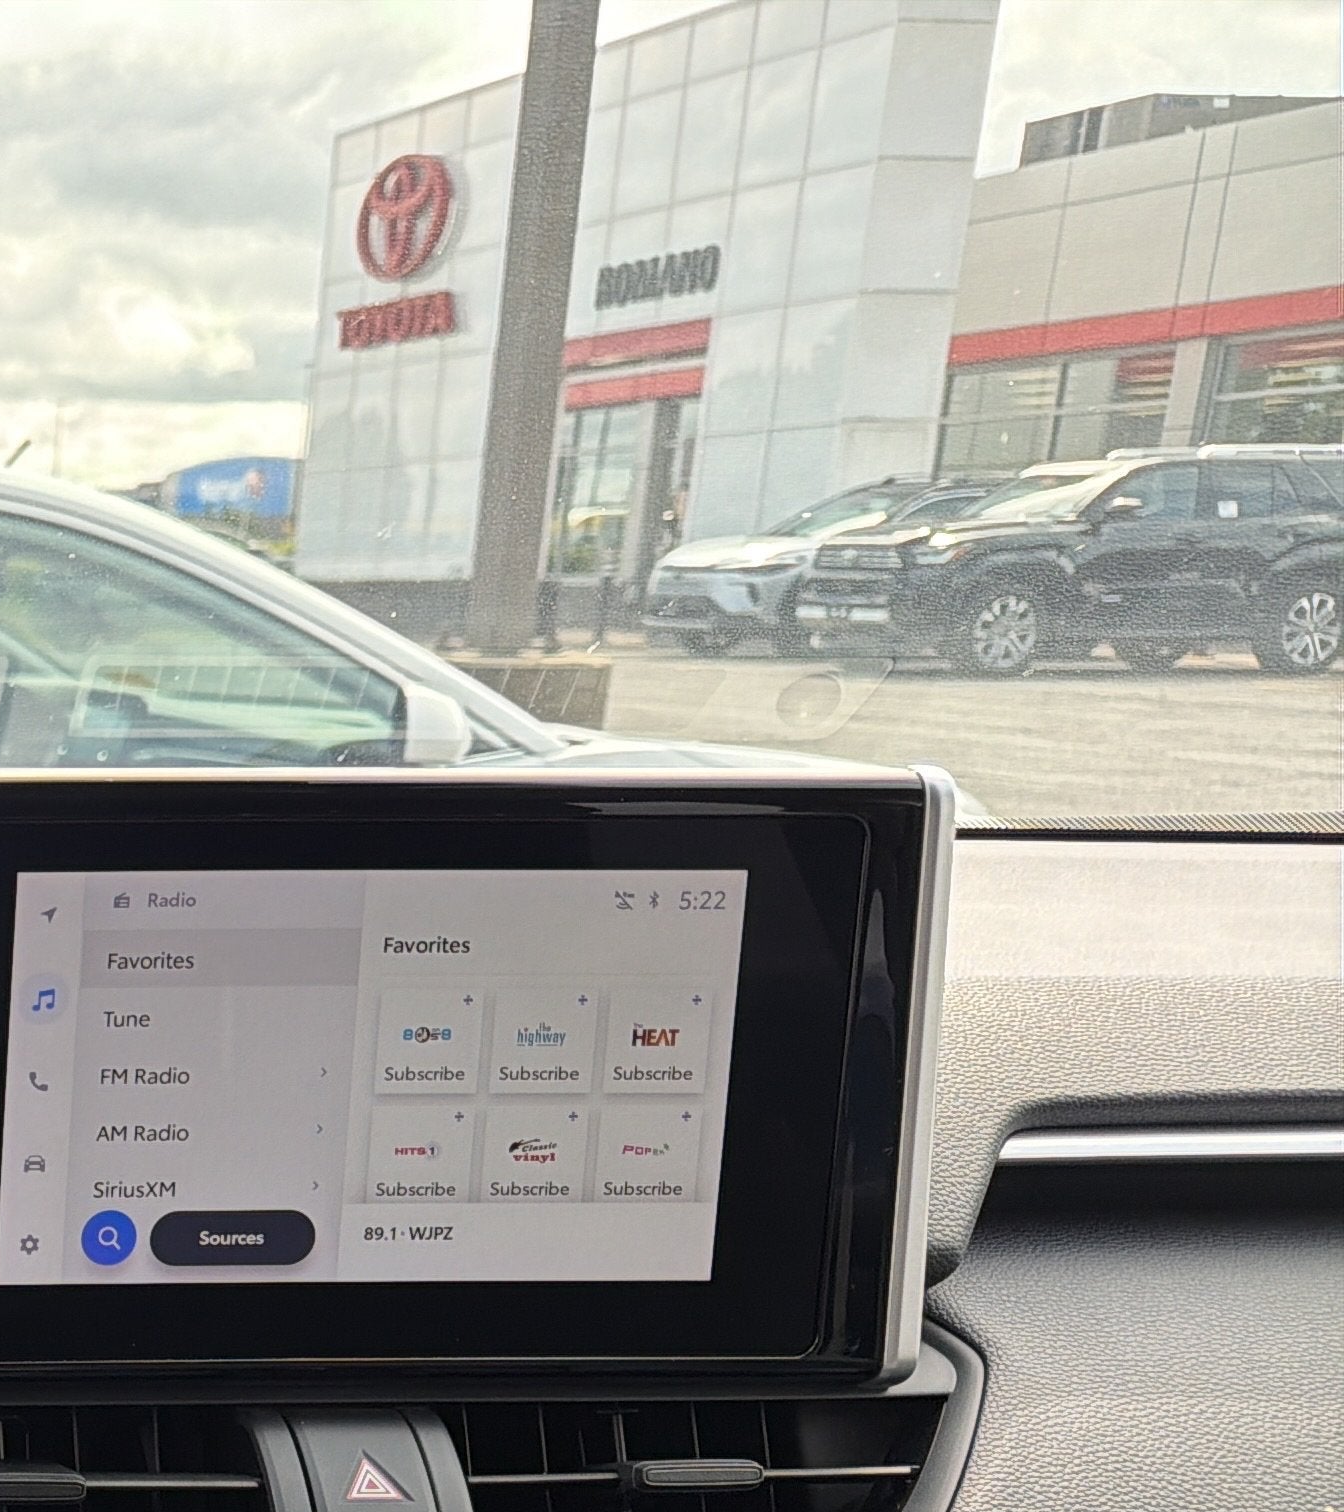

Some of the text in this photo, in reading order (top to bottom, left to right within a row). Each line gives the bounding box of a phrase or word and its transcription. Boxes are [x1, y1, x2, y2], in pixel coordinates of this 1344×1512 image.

[147, 892, 197, 908] Radio
[678, 890, 727, 910] 5:22
[383, 936, 471, 954] Favorites
[106, 951, 195, 970] Favorites
[103, 1010, 151, 1028] Tune
[516, 1027, 567, 1047] highway
[631, 1028, 680, 1047] HEAT
[100, 1066, 190, 1085] FM Radio
[384, 1066, 465, 1082] Subscribe
[499, 1066, 580, 1082] Subscribe
[612, 1066, 693, 1082] Subscribe
[96, 1123, 190, 1142] AM Radio
[394, 1146, 425, 1156] HITS
[513, 1153, 556, 1164] vinyl
[92, 1181, 176, 1198] SiriusXM
[376, 1182, 456, 1197] Subscribe
[490, 1182, 570, 1197] Subscribe
[603, 1182, 683, 1197] Subscribe
[198, 1230, 265, 1246] Sources
[364, 1226, 453, 1241] 89.1 WJPZ
